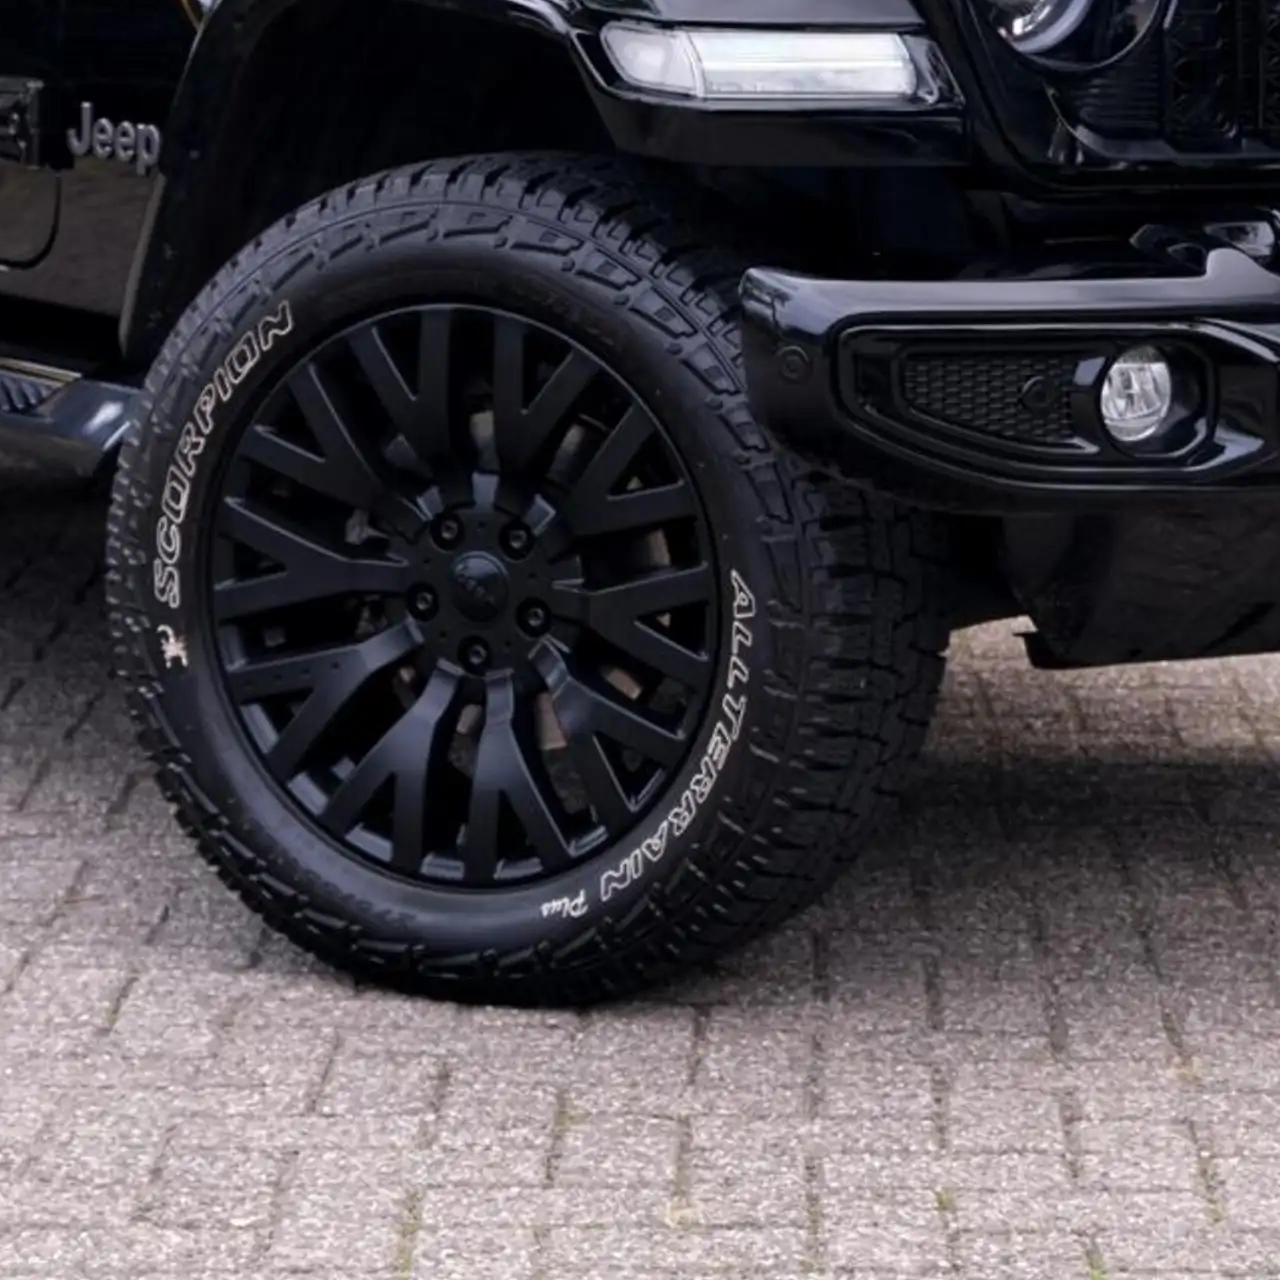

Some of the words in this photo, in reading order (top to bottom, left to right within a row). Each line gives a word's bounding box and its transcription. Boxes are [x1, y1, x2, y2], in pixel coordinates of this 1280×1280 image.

[66, 101, 161, 176] Jeep
[153, 300, 295, 609] SCORPION
[540, 888, 589, 919] Plus
